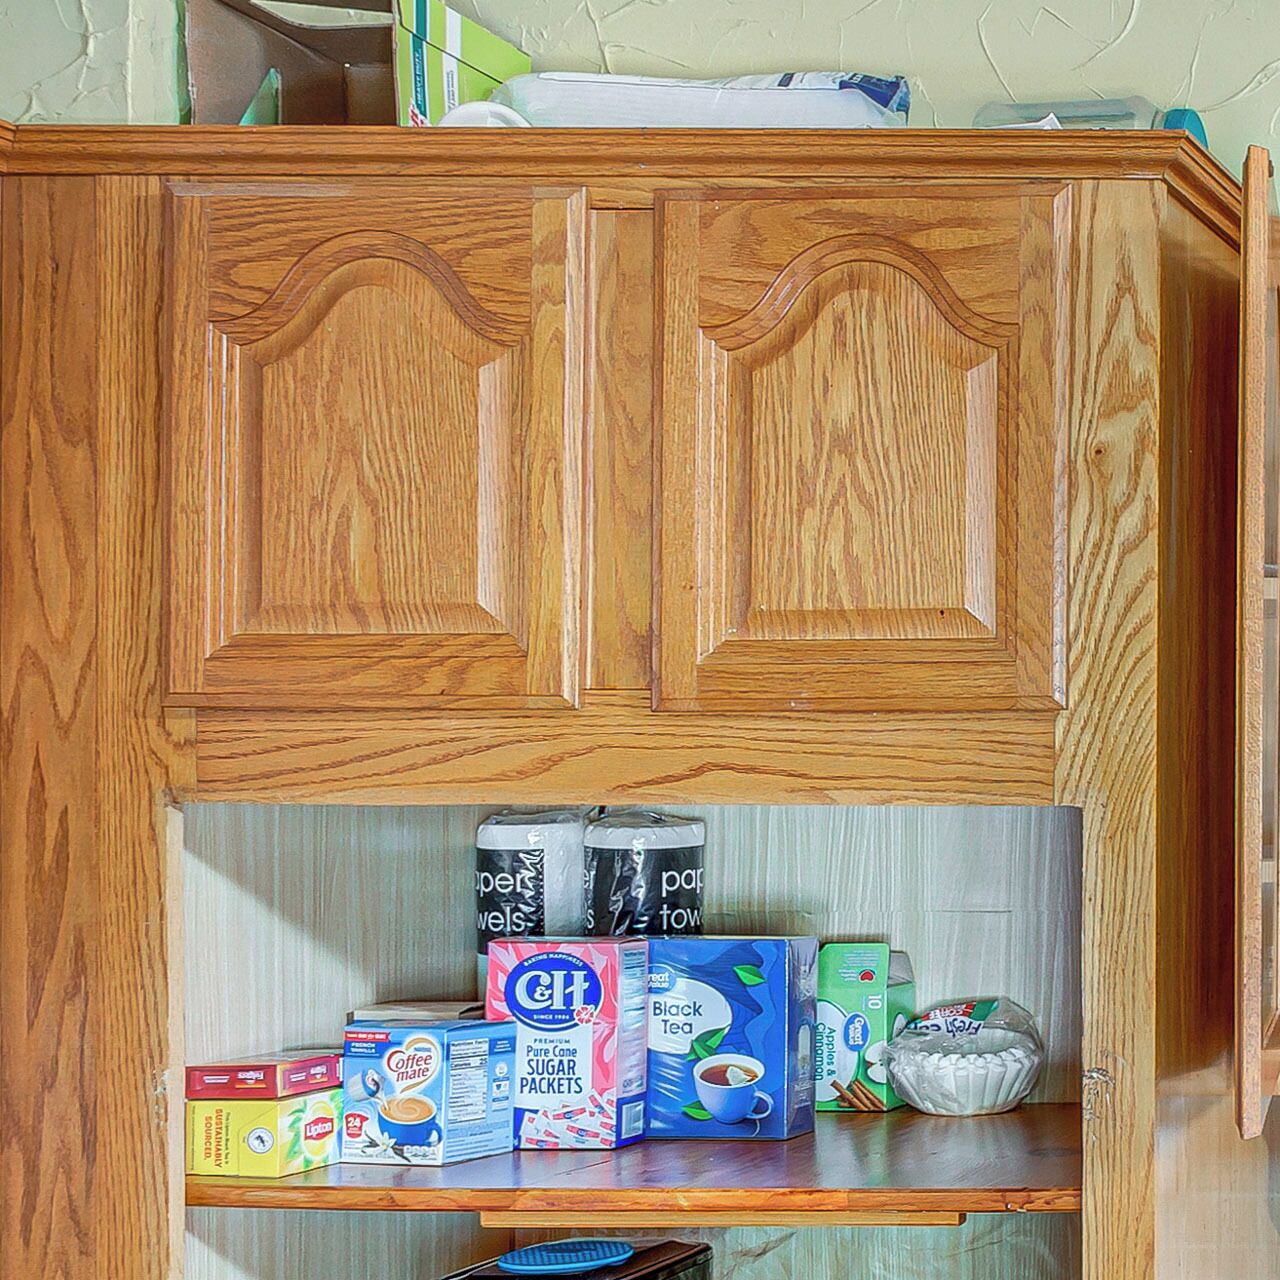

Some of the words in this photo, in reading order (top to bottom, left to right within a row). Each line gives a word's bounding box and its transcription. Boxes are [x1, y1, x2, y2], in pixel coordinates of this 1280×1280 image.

[648, 972, 669, 982] reat
[515, 970, 590, 1010] C&H
[653, 1001, 703, 1017] Black
[868, 994, 882, 1009] 10
[661, 1020, 693, 1034] Tea
[853, 1017, 865, 1045] Great
[944, 1018, 981, 1038] Fresh
[526, 1045, 549, 1057] Pure
[552, 1045, 577, 1057] Cane
[815, 1022, 826, 1081] Cinnamon
[825, 1026, 837, 1065] Apples
[387, 1050, 432, 1073] Coffee
[527, 1059, 576, 1076] SUGAR
[396, 1067, 429, 1082] mate
[827, 1069, 836, 1077] &
[520, 1077, 583, 1094] PACKETS
[306, 1121, 332, 1137] Lipton
[347, 1118, 361, 1128] 24
[214, 1109, 223, 1168] SUSTAINABLY
